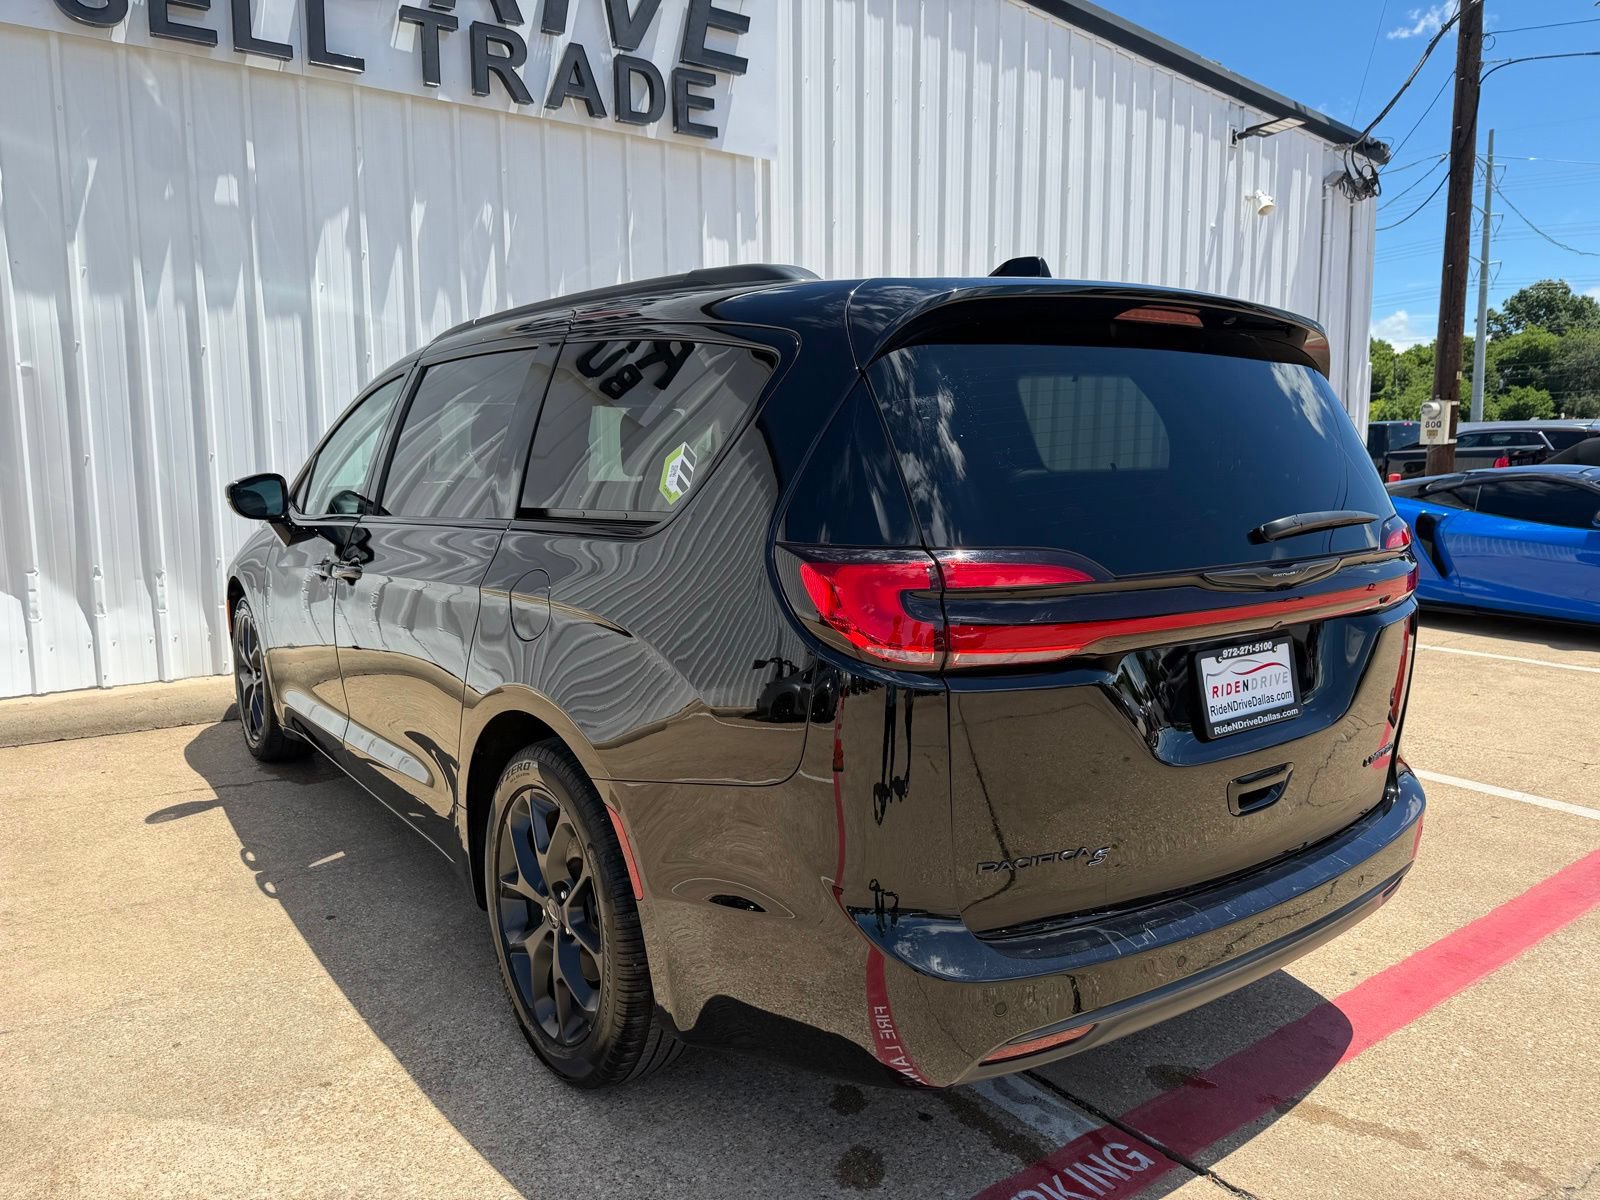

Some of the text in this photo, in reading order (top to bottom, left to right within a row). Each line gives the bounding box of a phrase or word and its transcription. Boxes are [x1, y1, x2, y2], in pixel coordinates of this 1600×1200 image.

[399, 4, 719, 139] TRADE
[1425, 420, 1442, 429] 800
[1222, 641, 1273, 659] 972-271-5100
[1210, 690, 1293, 717] RideNDriveDallas.com
[1214, 708, 1299, 735] RideNDriveDallas.com
[976, 846, 1091, 875] PACIFICA
